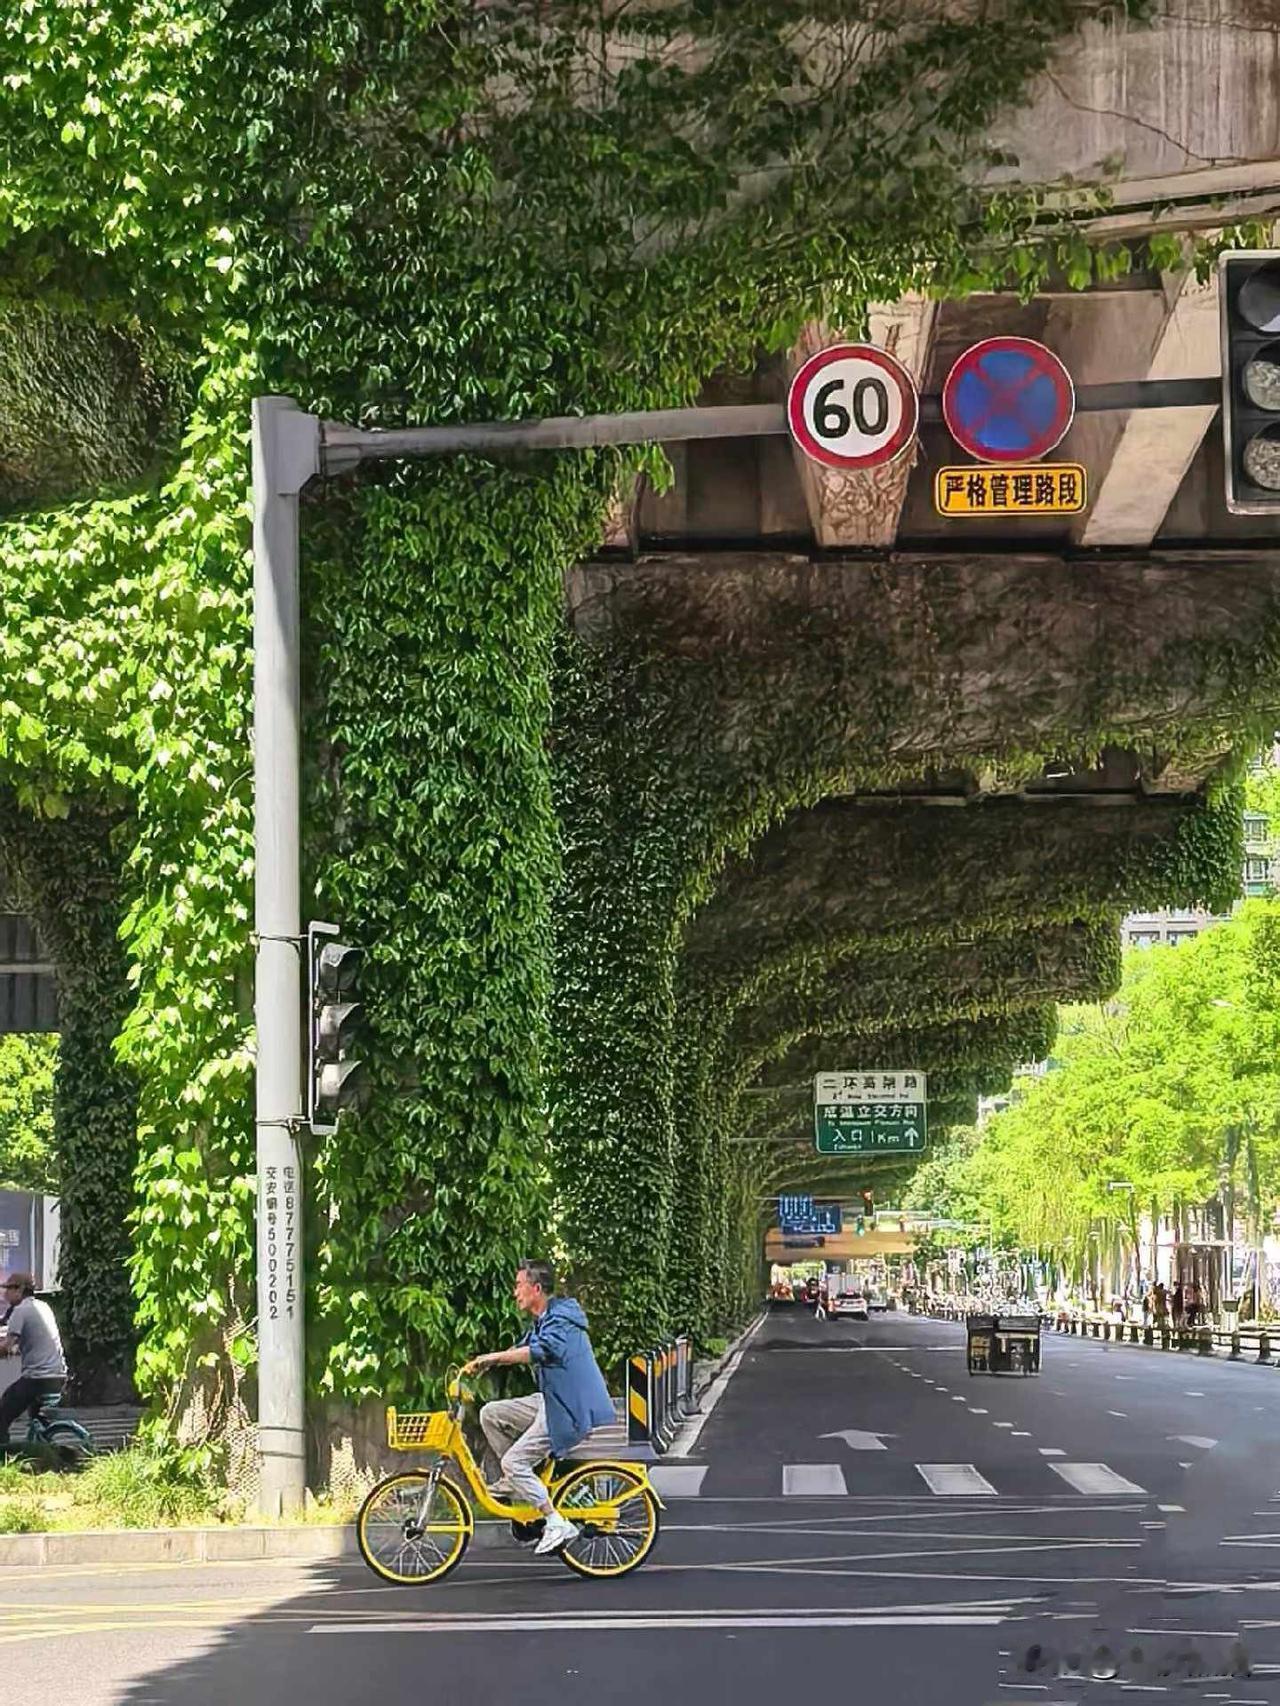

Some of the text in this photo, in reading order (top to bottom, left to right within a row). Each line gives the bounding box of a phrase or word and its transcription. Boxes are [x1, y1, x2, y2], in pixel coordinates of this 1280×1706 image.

[813, 377, 889, 439] 60
[945, 472, 1079, 508] 严格管理路段
[832, 1128, 863, 1142] 入口
